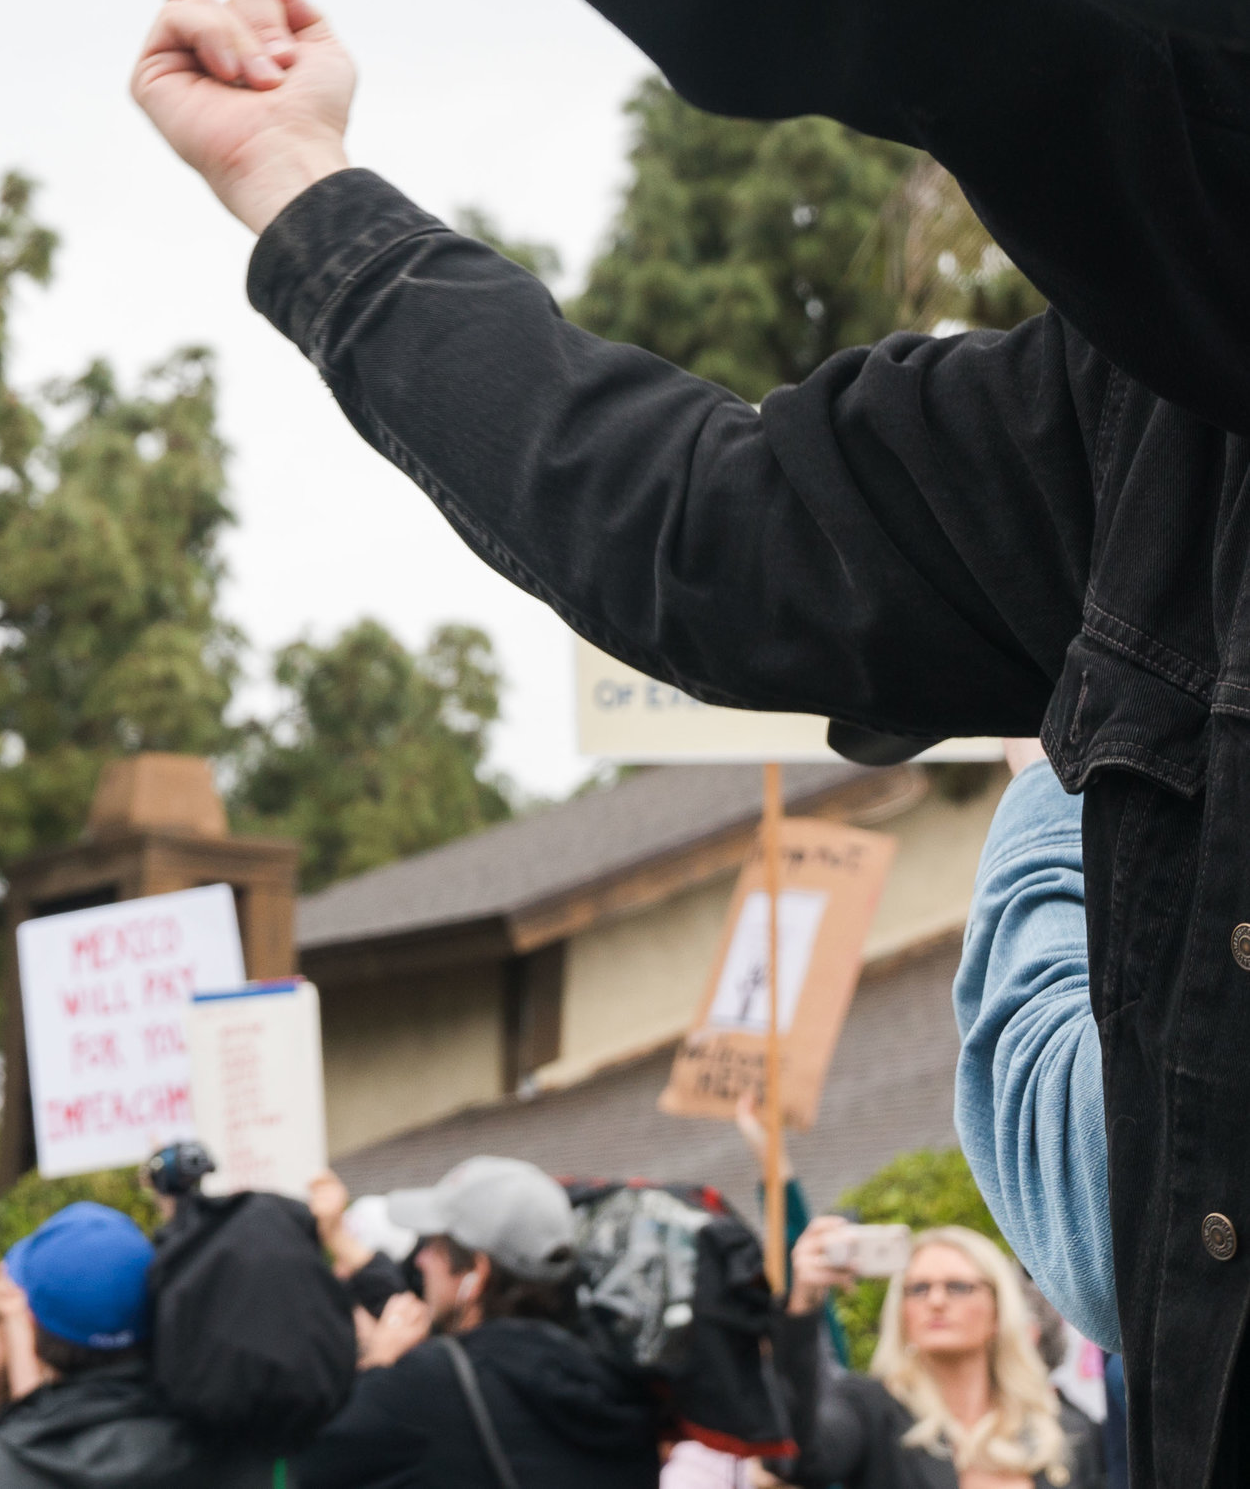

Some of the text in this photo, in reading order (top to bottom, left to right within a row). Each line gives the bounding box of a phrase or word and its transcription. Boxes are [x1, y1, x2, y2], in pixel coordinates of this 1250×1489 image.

[594, 678, 633, 712] OF
[70, 915, 182, 971] MEXICO
[62, 979, 130, 1017] WILL
[72, 1031, 120, 1074] FOR
